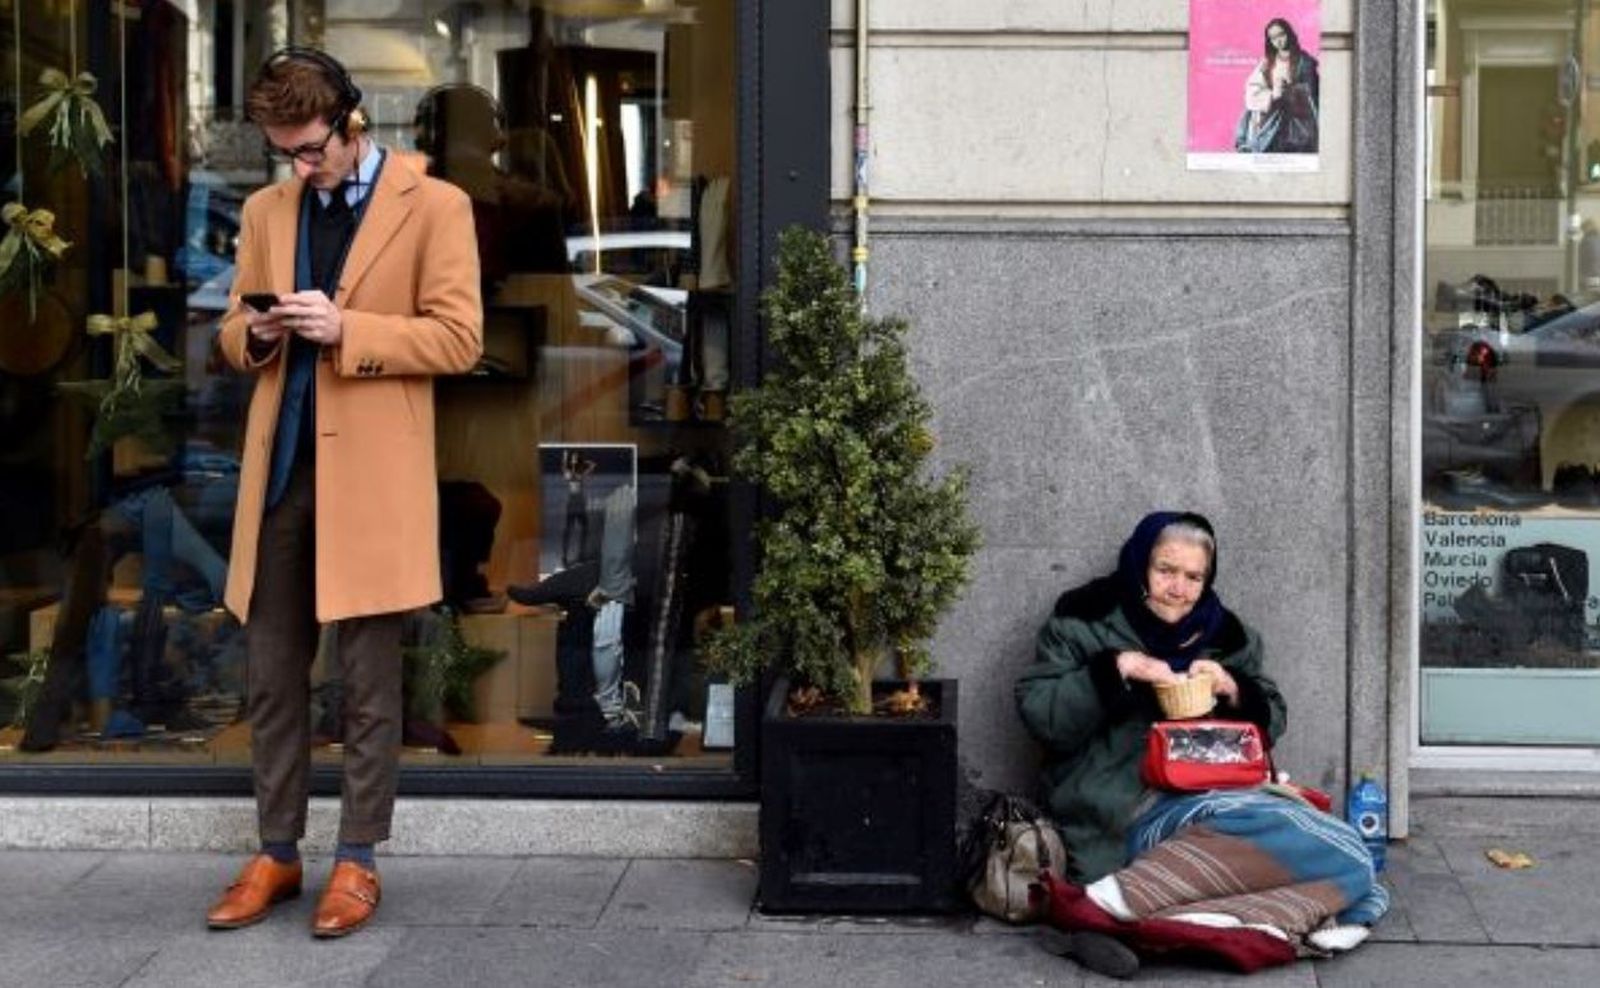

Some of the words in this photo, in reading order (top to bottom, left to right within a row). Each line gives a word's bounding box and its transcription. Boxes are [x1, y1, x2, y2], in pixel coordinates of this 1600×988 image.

[1423, 511, 1521, 526] Barcelona
[1425, 531, 1506, 547] Valencia
[1424, 551, 1487, 566] Murcia
[1424, 570, 1492, 588] Oviedo
[1424, 592, 1455, 607] Pal
